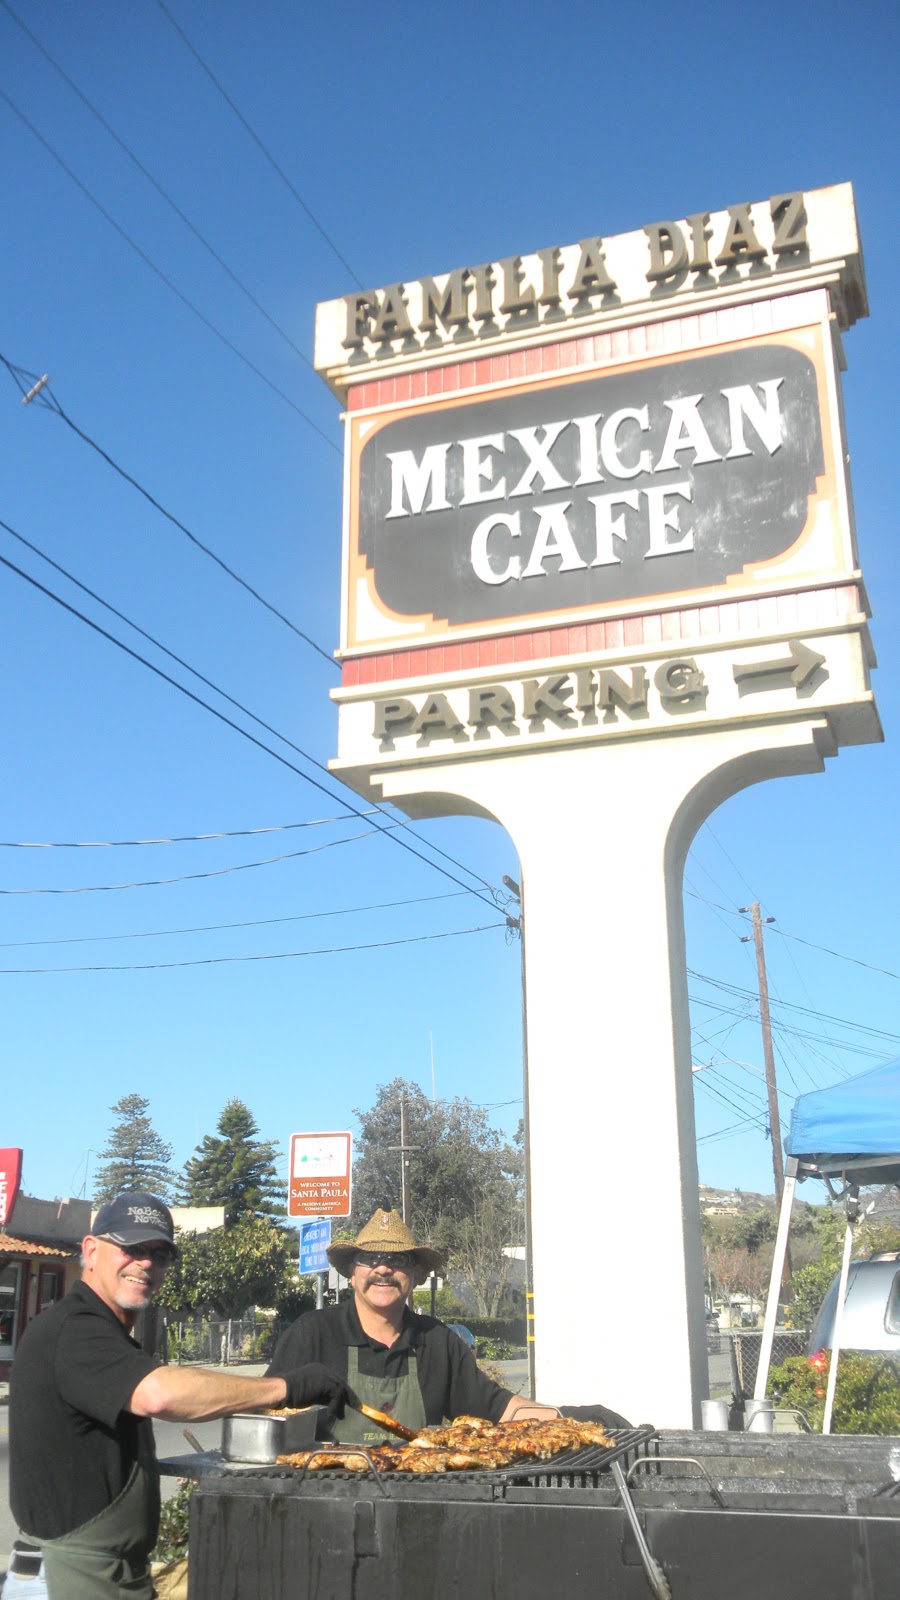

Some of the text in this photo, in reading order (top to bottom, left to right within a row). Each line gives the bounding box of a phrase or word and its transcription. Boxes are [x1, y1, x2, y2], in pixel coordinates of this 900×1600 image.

[343, 191, 806, 352] FAMILIA DIAZ
[385, 378, 785, 519] MEXICAN
[470, 481, 694, 586] CAFE
[372, 657, 709, 741] PARKING
[291, 1188, 348, 1198] SANTA PAULA
[363, 1432, 387, 1441] TEAM
